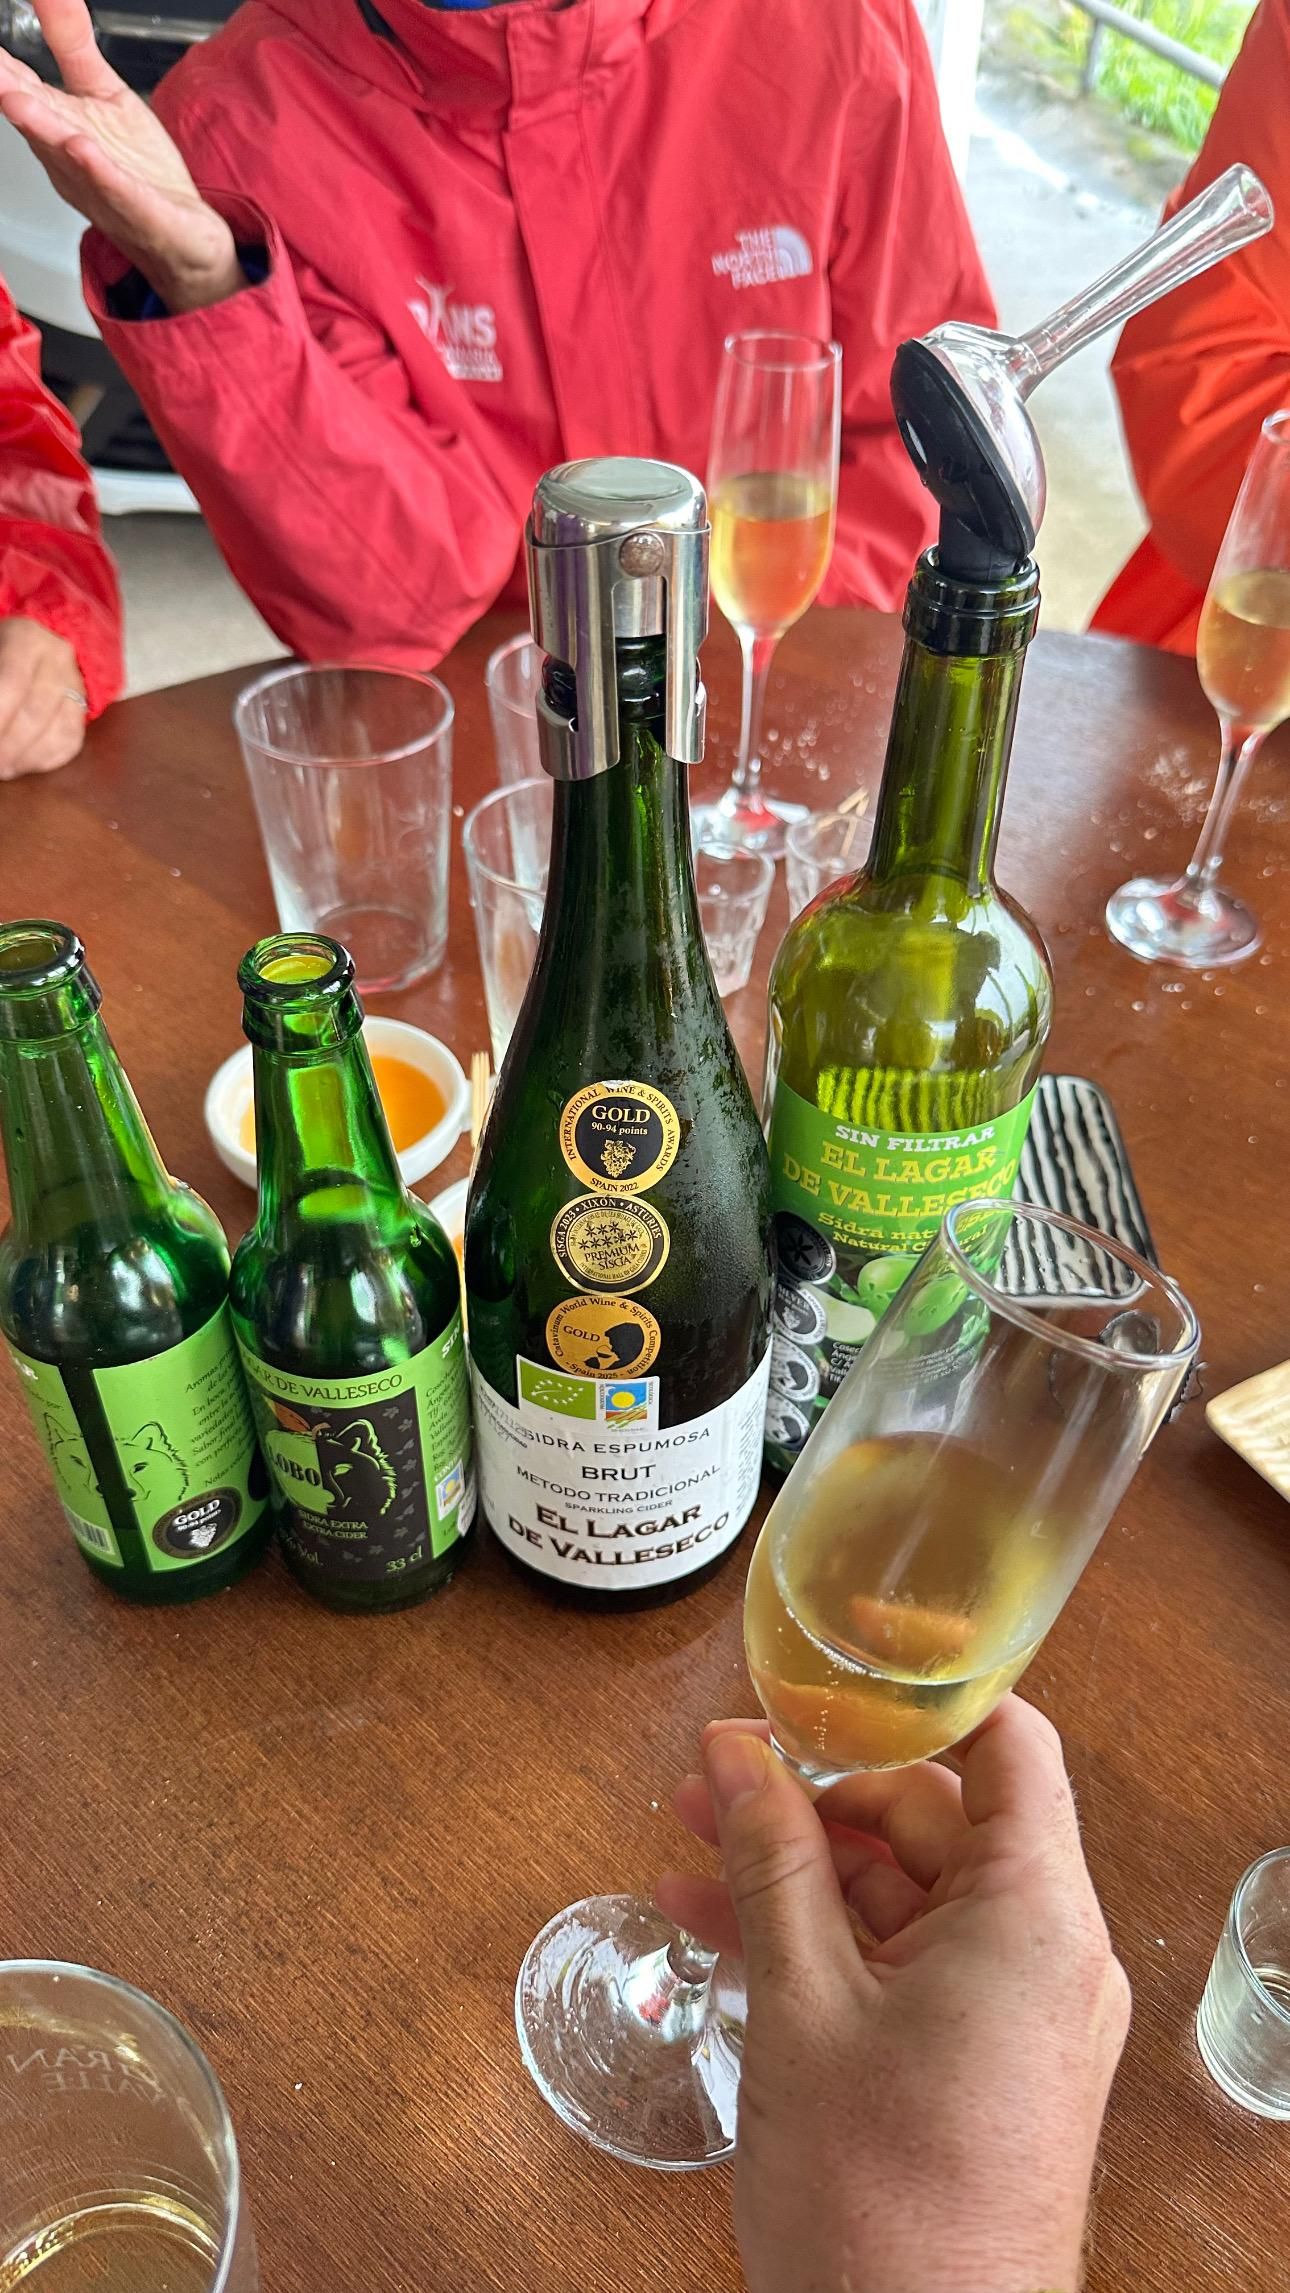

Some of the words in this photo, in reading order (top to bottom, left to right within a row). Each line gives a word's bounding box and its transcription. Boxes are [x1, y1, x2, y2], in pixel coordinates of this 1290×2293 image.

[735, 228, 771, 251] THE
[711, 248, 778, 276] NORTH
[731, 268, 775, 290] FACE
[605, 1085, 636, 1094] WINE
[637, 1089, 646, 1098] &
[591, 1105, 651, 1123] GOLD
[646, 1093, 674, 1125] SPIRITS
[563, 1088, 602, 1161] INTERNATIONAL
[591, 1121, 617, 1133] 90-94
[619, 1126, 648, 1136] points
[835, 1124, 881, 1149] SIN
[886, 1125, 995, 1153] FILTRAR
[655, 1128, 676, 1172] AWARDS
[820, 1140, 866, 1177] EL
[873, 1144, 999, 1185] LAGAR
[590, 1177, 619, 1192] SPAIN
[620, 1181, 640, 1192] 2022
[783, 1152, 822, 1197] DE
[827, 1158, 1017, 1217] VALLESECO
[579, 1196, 617, 1211] XIXÓN
[560, 1210, 577, 1229] 2023
[625, 1202, 663, 1239] ASTURIES
[817, 1211, 884, 1239] Sidra
[556, 1231, 568, 1258] SISGA
[832, 1230, 909, 1252] Natural
[584, 1243, 640, 1263] PREMIUM
[598, 1258, 632, 1271] SISGA
[560, 1298, 588, 1314] World
[589, 1297, 617, 1307] Wine
[619, 1301, 629, 1310] &
[629, 1306, 653, 1329] Spirits
[550, 1313, 564, 1357] Catavinum
[563, 1325, 601, 1342] GOLD
[627, 1330, 658, 1376] Competition
[185, 1365, 218, 1393] Aromas
[569, 1361, 596, 1379] Spain
[274, 1375, 299, 1395] DE
[300, 1374, 403, 1400] VALLESECO
[192, 1404, 206, 1417] En
[192, 1435, 218, 1457] Sabor
[526, 1429, 586, 1453] SIDRA
[594, 1427, 711, 1454] ESPUMOSA
[268, 1444, 321, 1486] LOBO
[581, 1464, 657, 1482] BRUT
[204, 1467, 229, 1488] Notas
[516, 1464, 591, 1501] METODO
[596, 1463, 720, 1503] TRADICIONAL
[173, 1499, 220, 1526] GOLD
[564, 1501, 634, 1515] SPARKLING
[636, 1499, 673, 1513] CIDER
[298, 1509, 330, 1527] SIDRA
[330, 1520, 369, 1529] EXTRA
[303, 1520, 334, 1537] EXTRA
[335, 1530, 369, 1539] CIDER
[535, 1502, 579, 1535] EL
[586, 1503, 702, 1540] LAGAR
[508, 1513, 544, 1550] DE
[549, 1511, 730, 1566] VALLESECO
[385, 1558, 406, 1573] 33
[409, 1546, 423, 1563] cl
